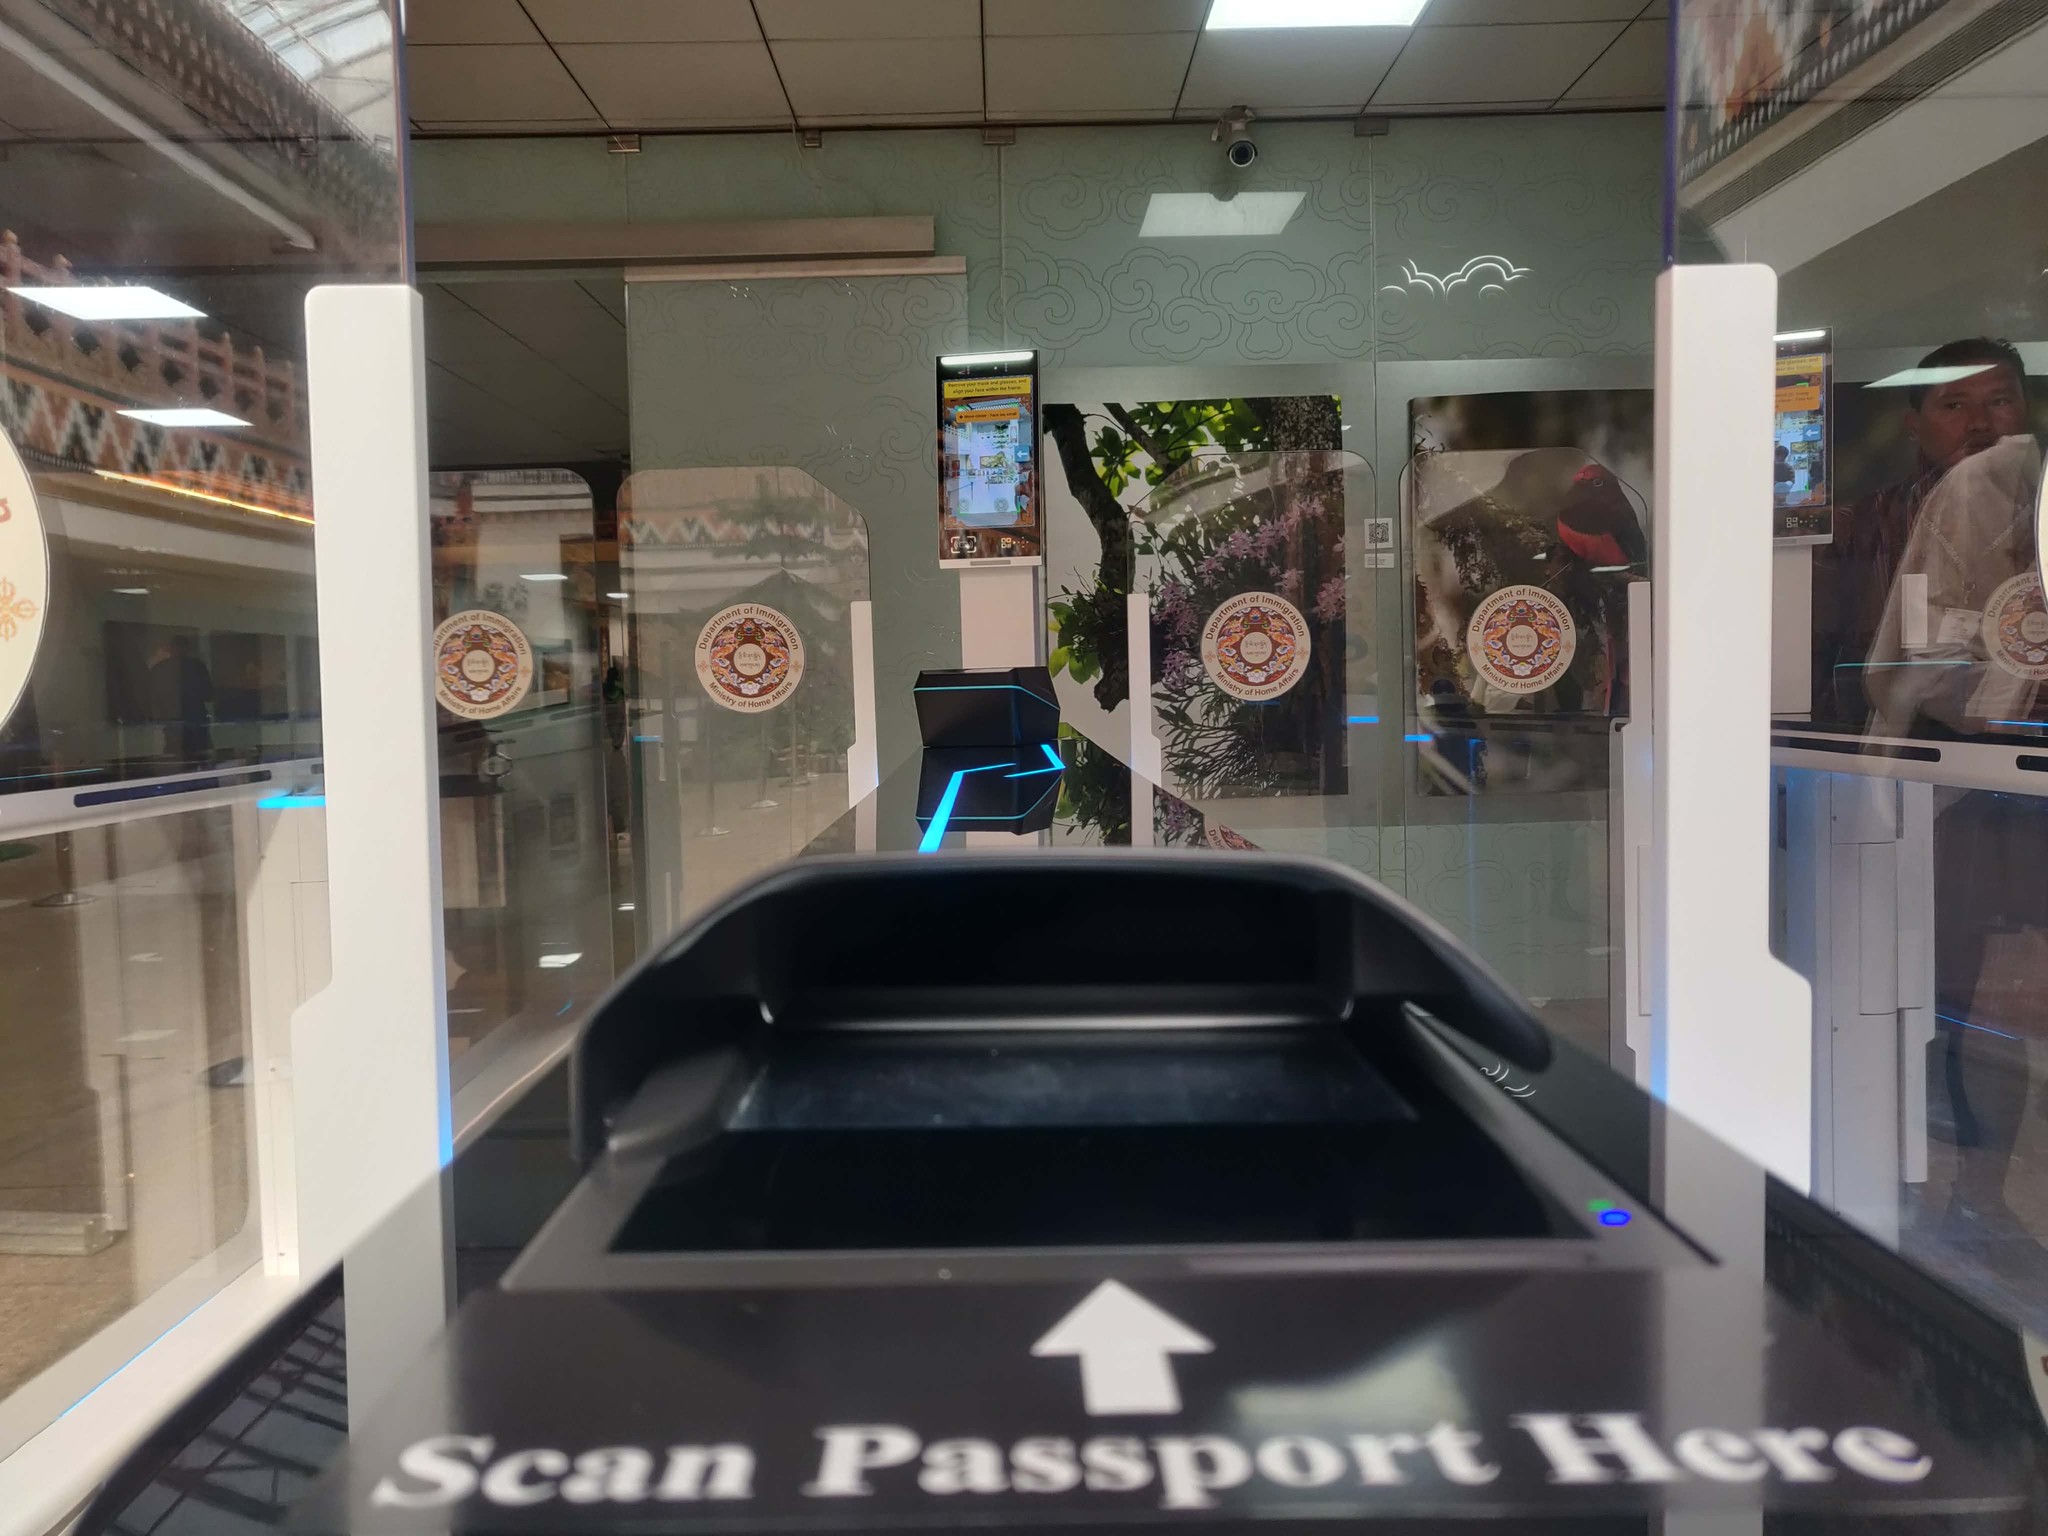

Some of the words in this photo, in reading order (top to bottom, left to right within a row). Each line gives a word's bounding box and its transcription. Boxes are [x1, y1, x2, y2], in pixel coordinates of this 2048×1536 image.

[1205, 597, 1247, 640] Department
[1249, 595, 1260, 603] of
[1261, 595, 1305, 637] Immigration
[1471, 590, 1514, 632] Department
[1516, 588, 1526, 596] of
[1528, 588, 1571, 631] Immigration
[1987, 576, 2032, 618] Department
[470, 613, 480, 621] of
[482, 613, 527, 655] Immigration
[698, 607, 741, 650] Department
[743, 606, 753, 615] of
[756, 607, 799, 650] Immigration
[708, 681, 736, 706] Ministry
[748, 699, 771, 708] Home
[772, 681, 793, 701] Affairs
[1215, 671, 1243, 694] Ministry
[1245, 688, 1254, 696] of
[1254, 686, 1277, 696] Home
[1278, 668, 1299, 689] Affairs
[1481, 663, 1509, 687] Ministry
[1510, 681, 1520, 689] of
[1520, 679, 1543, 689] Home
[1544, 661, 1565, 682] Affairs
[438, 689, 467, 713] Ministry
[468, 706, 477, 714] of
[479, 704, 502, 714] Home
[502, 685, 522, 707] Affairs
[373, 1434, 756, 1507] Scan
[803, 1420, 1502, 1510] Passport
[1511, 1412, 1934, 1485] Here
